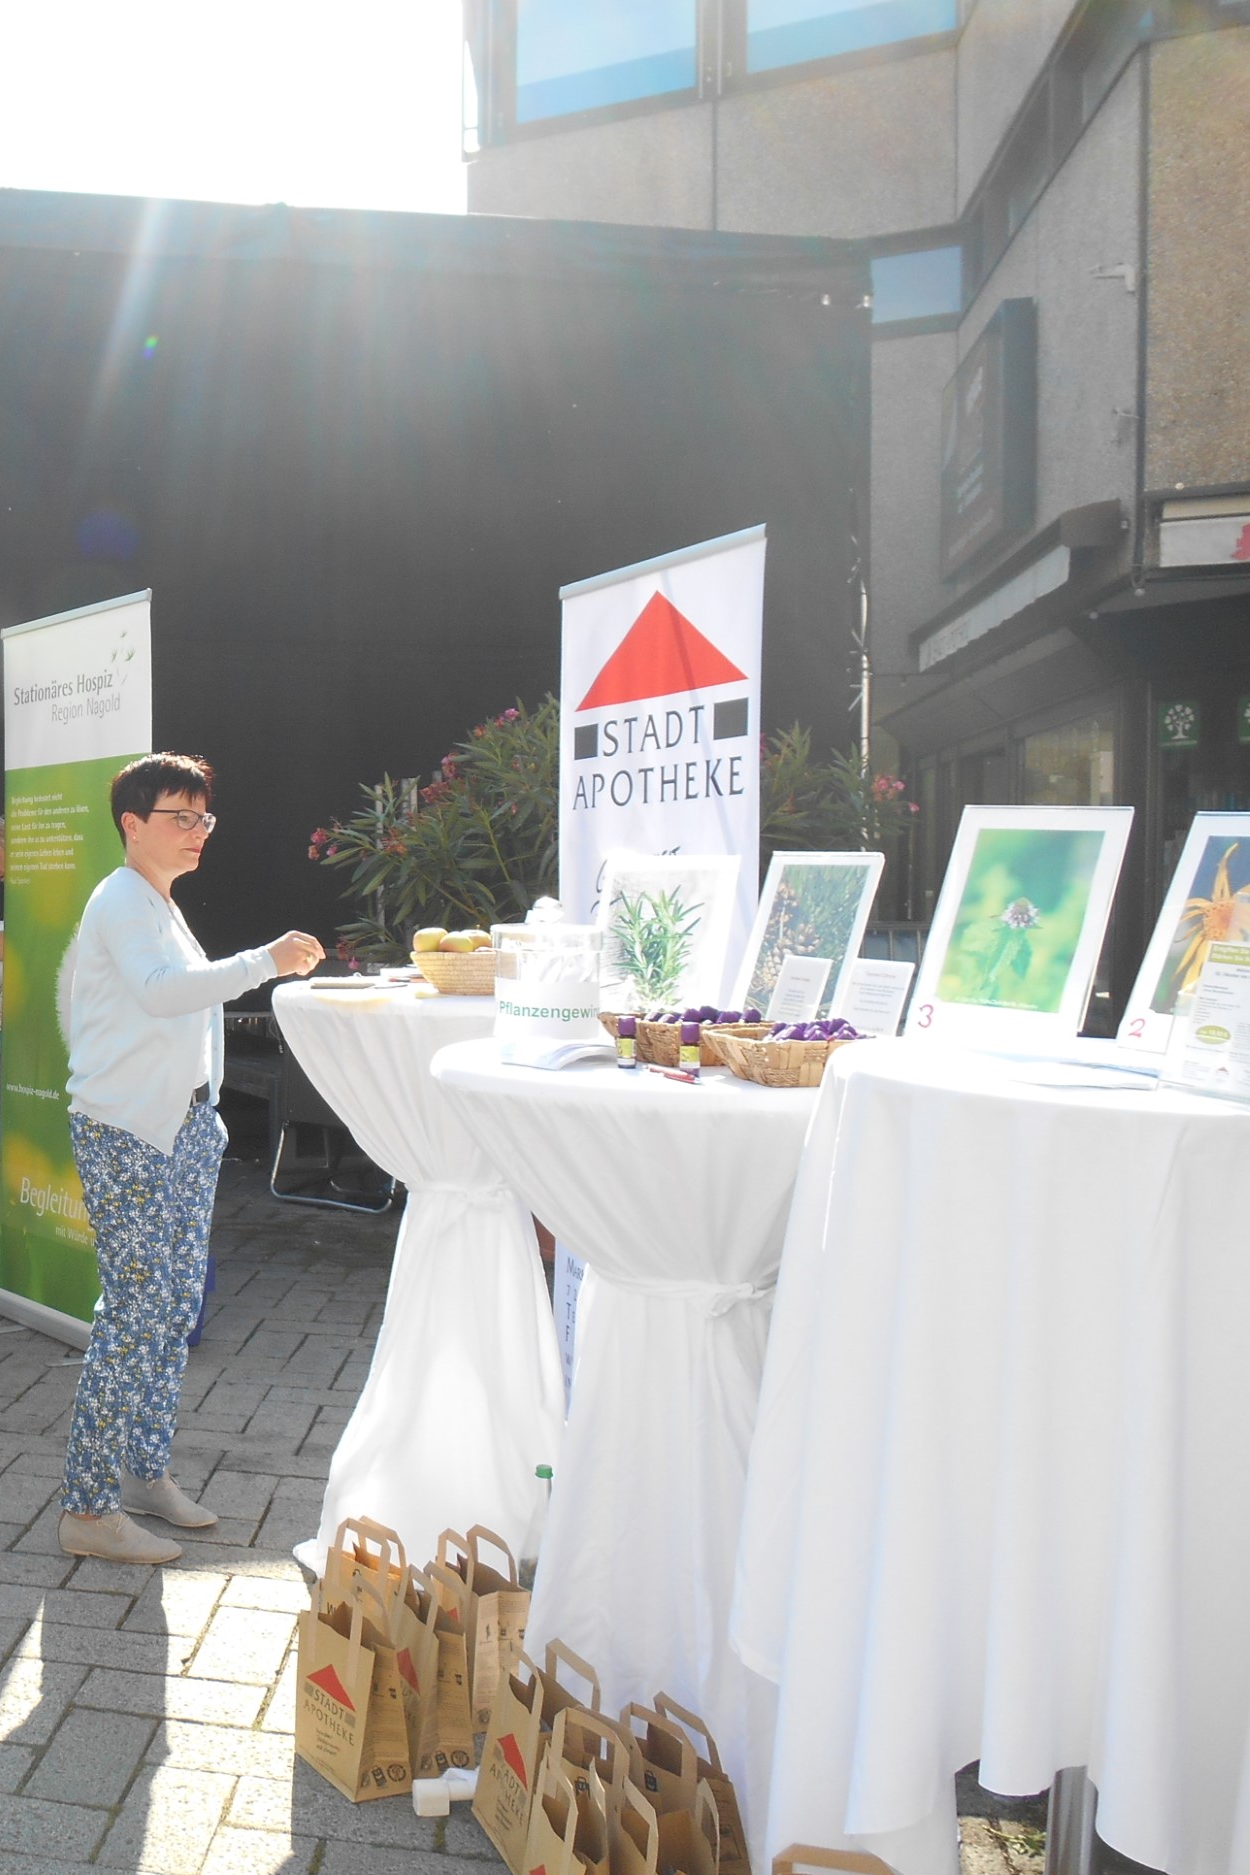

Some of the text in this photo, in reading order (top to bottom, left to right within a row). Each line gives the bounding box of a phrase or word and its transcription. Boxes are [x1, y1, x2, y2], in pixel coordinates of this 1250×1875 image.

[14, 669, 113, 705] Stationäres Hospiz
[52, 692, 121, 725] Region Nagold
[602, 705, 705, 757] STADT
[572, 756, 744, 810] APOTHEKE
[917, 1004, 934, 1028] 3
[1128, 1018, 1146, 1038] 2
[55, 1225, 66, 1238] mit
[314, 1689, 345, 1721] STADT
[303, 1698, 355, 1747] APOTHEKE
